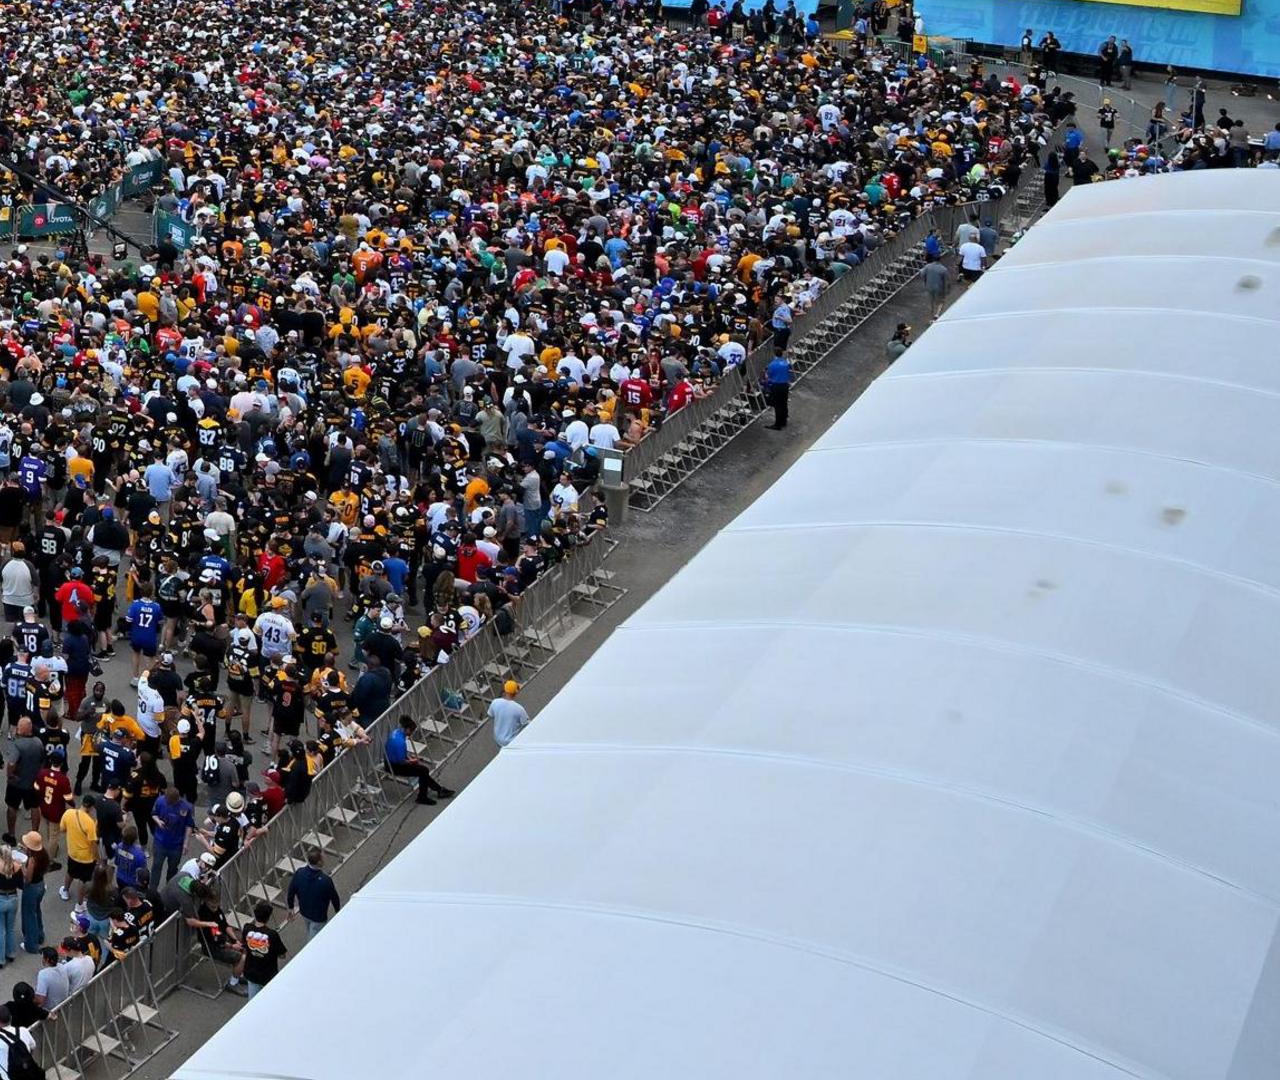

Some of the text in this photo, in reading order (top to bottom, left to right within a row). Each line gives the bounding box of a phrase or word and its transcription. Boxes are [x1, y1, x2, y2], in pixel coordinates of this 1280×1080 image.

[628, 392, 640, 404] 15
[110, 423, 126, 436] 92
[92, 438, 105, 452] 90
[200, 430, 216, 445] 87
[220, 456, 234, 472] 88
[26, 470, 34, 484] 9
[42, 540, 56, 554] 98
[138, 613, 152, 628] 17
[264, 626, 280, 644] 43
[24, 634, 38, 652] 18
[312, 641, 328, 655] 90
[6, 678, 24, 698] 82
[104, 756, 115, 772] 3
[44, 787, 54, 805] 5
